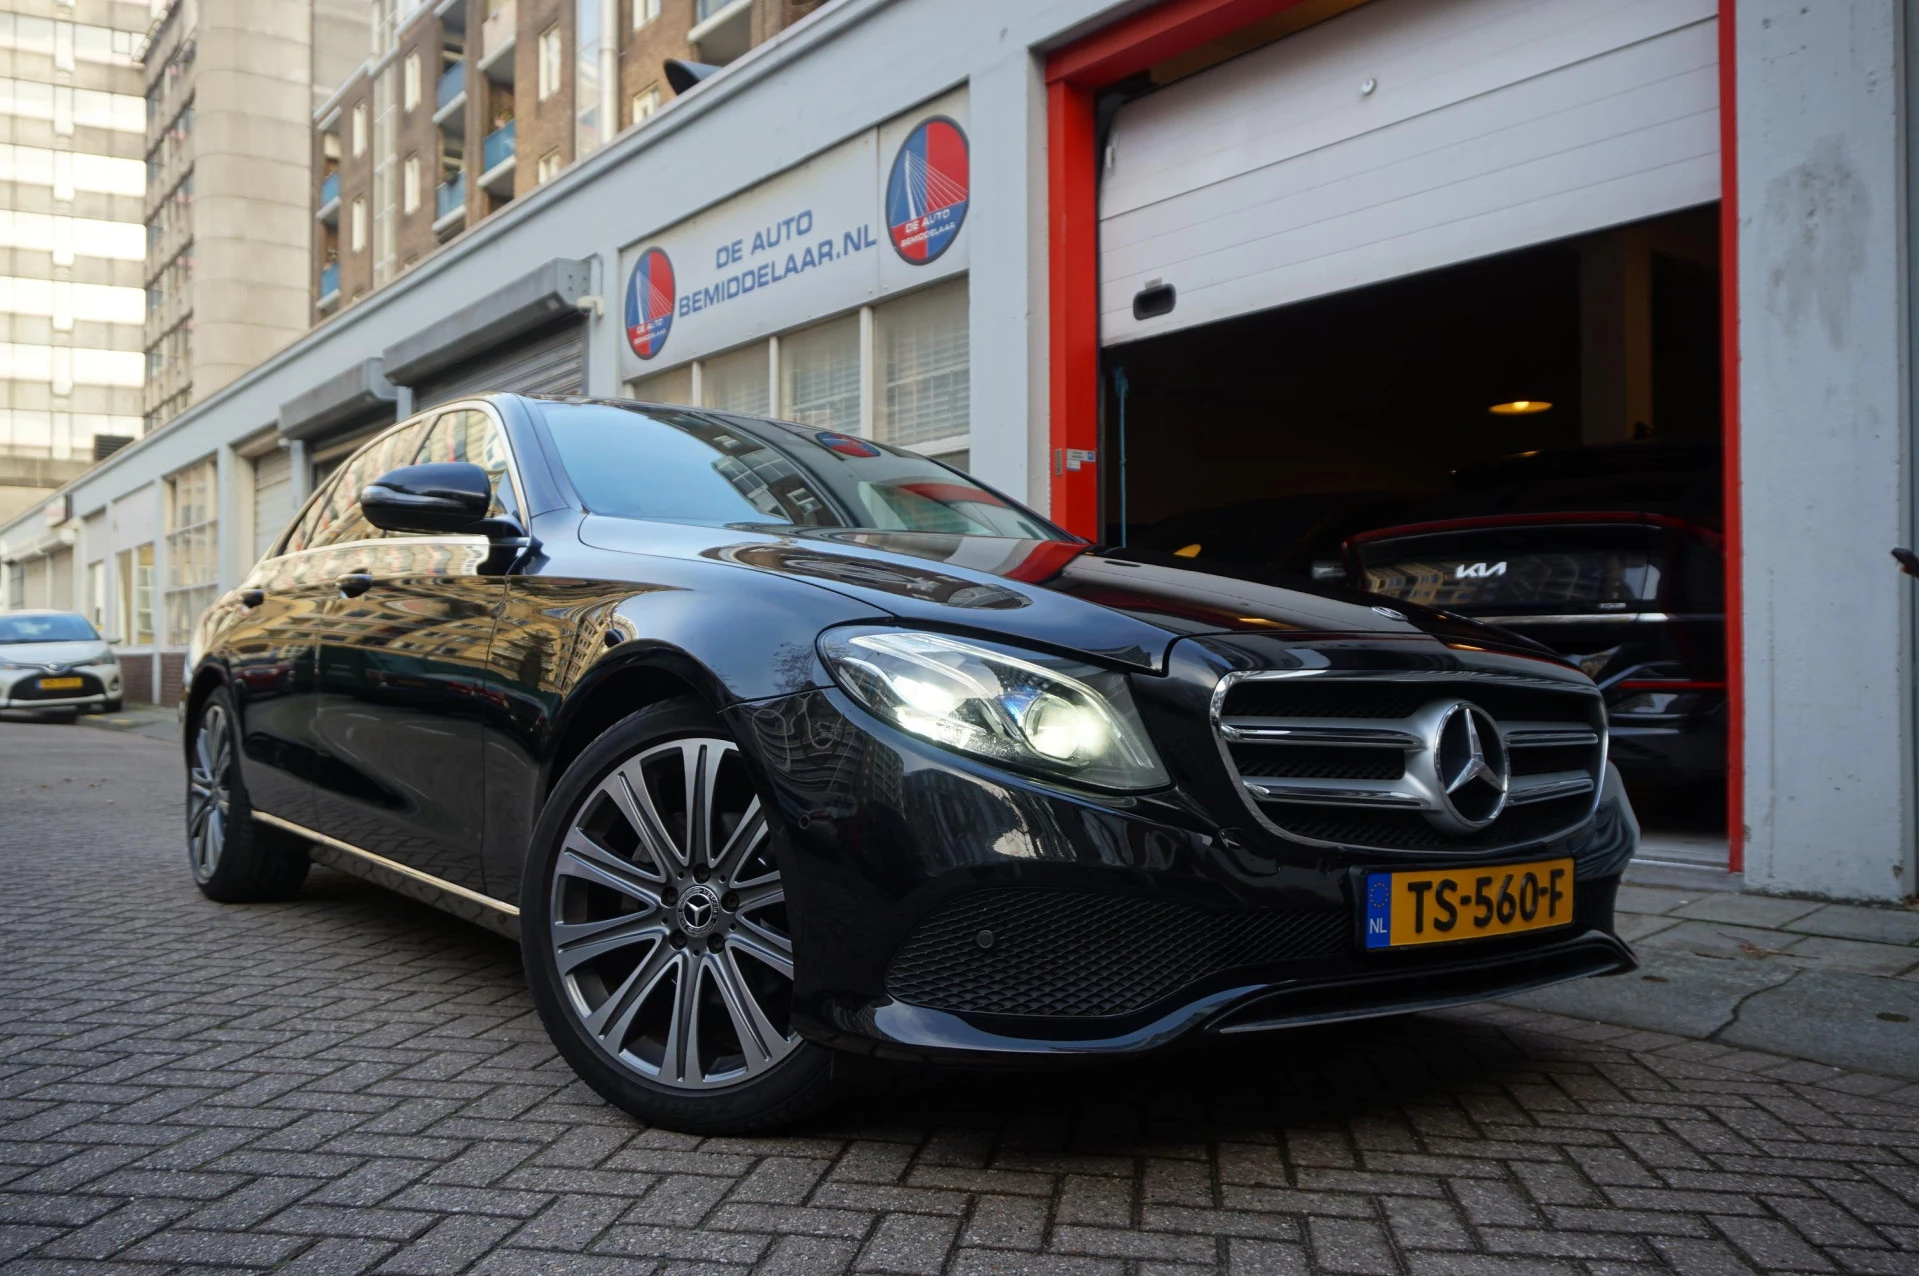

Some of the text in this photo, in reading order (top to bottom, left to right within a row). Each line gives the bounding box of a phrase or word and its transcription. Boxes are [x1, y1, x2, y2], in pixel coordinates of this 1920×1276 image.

[716, 209, 813, 270] DE AUTO
[905, 208, 950, 234] DE AUTO
[679, 224, 878, 318] BEMIDDELAAR.NL
[1369, 918, 1388, 935] NL
[1407, 868, 1566, 934] TS-560-F
